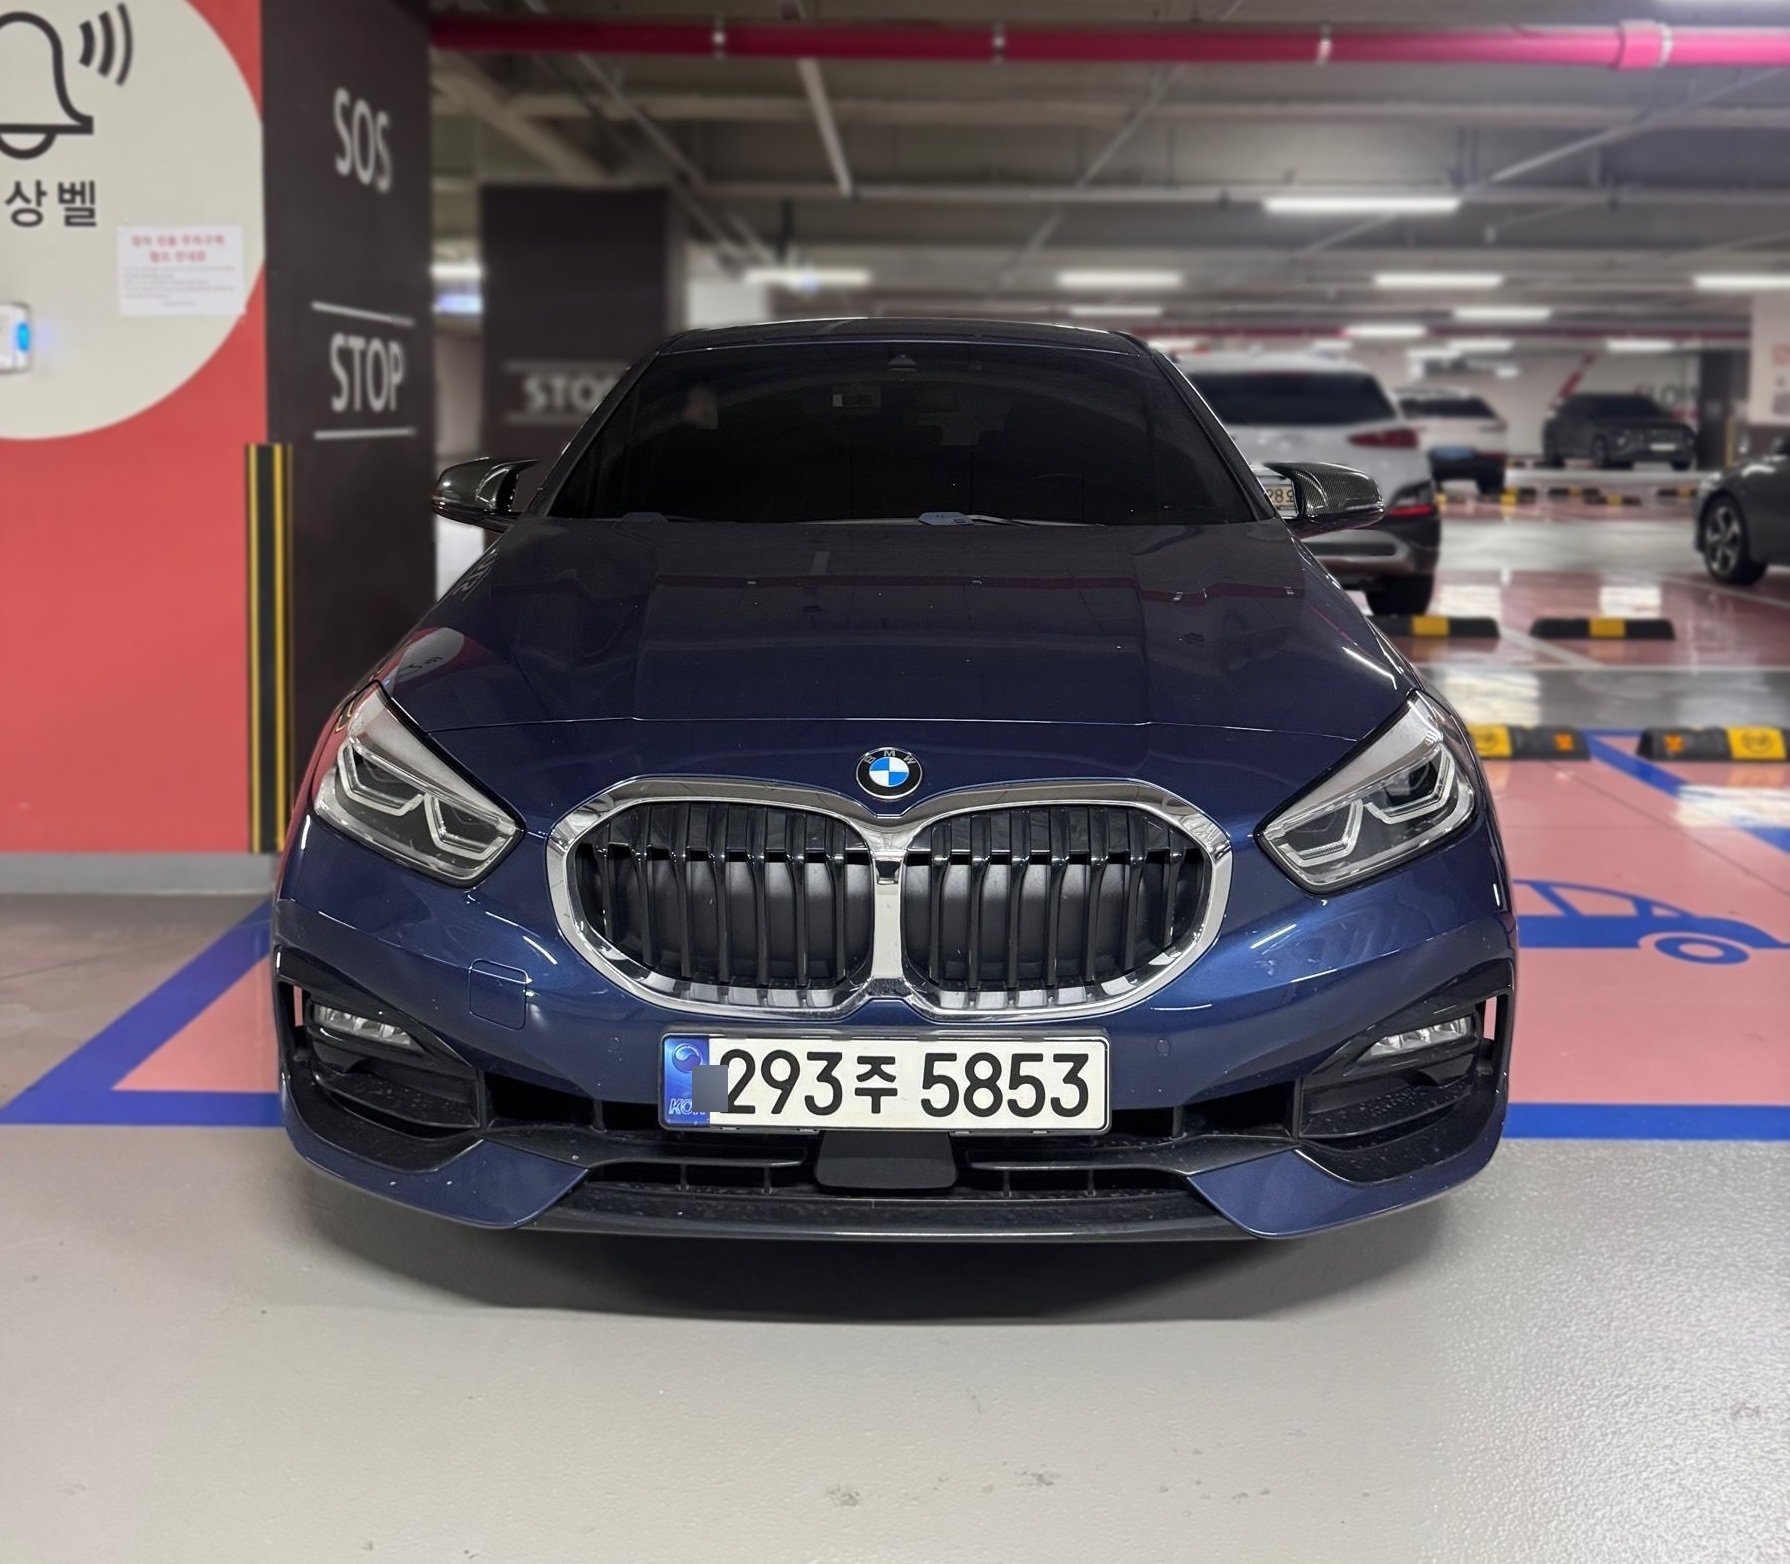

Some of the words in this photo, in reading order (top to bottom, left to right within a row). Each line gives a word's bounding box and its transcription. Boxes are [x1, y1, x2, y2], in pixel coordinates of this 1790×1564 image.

[332, 87, 391, 193] SOS
[330, 332, 404, 412] STOP
[863, 750, 917, 765] BMW
[668, 1098, 706, 1116] KO
[719, 1048, 898, 1115] 293주
[920, 1052, 1089, 1118] 5853
